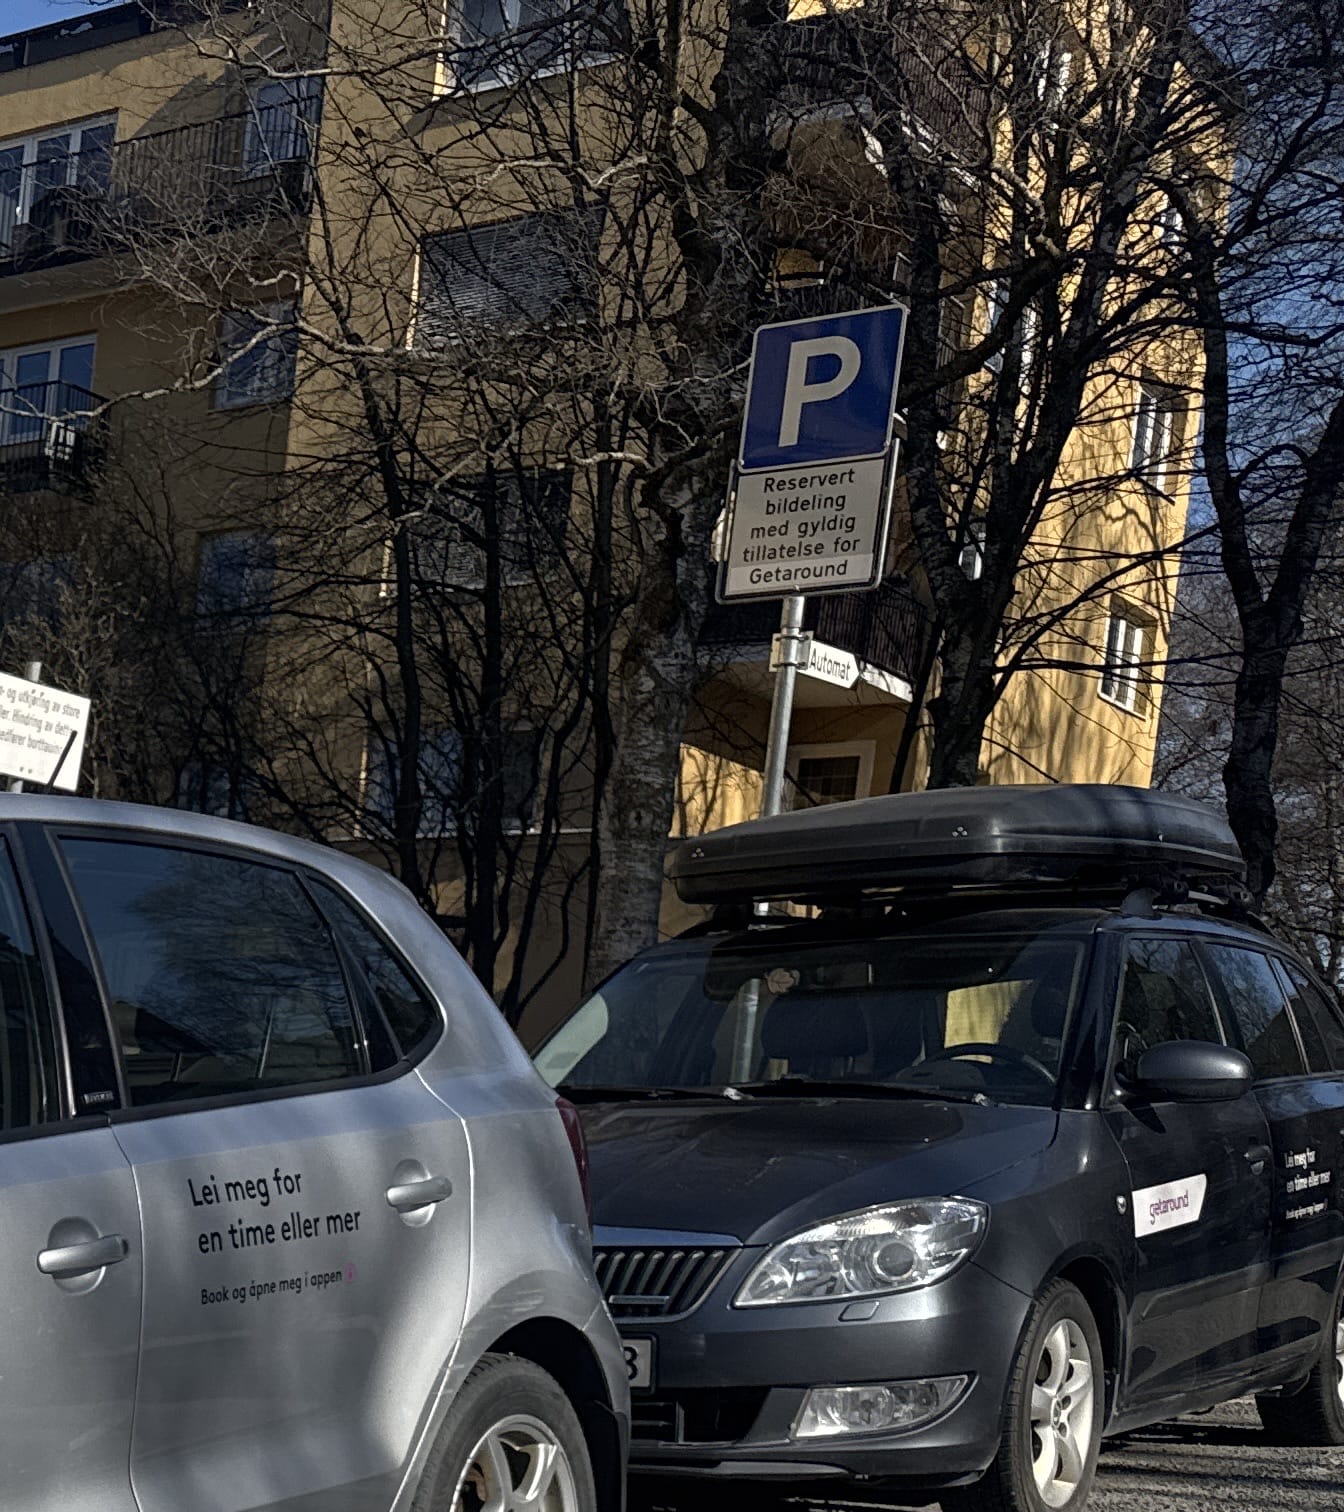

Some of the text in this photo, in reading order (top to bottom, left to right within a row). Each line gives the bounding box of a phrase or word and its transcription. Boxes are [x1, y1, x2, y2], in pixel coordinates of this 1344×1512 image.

[778, 335, 861, 448] P
[763, 468, 855, 493] Reservert
[765, 494, 846, 516] bildeling
[750, 514, 856, 539] med gyldig
[742, 536, 861, 563] tillatelse for
[749, 560, 848, 584] Getaround
[809, 648, 852, 681] Automat
[7, 687, 17, 703] og
[188, 1168, 302, 1207] Lei meg for
[1149, 1190, 1190, 1226] getaround
[198, 1210, 361, 1254] en time eller mer
[201, 1286, 229, 1305] Book
[232, 1286, 246, 1303] og
[249, 1279, 276, 1300] åpne
[279, 1276, 302, 1294] meg
[310, 1269, 343, 1289] appen
